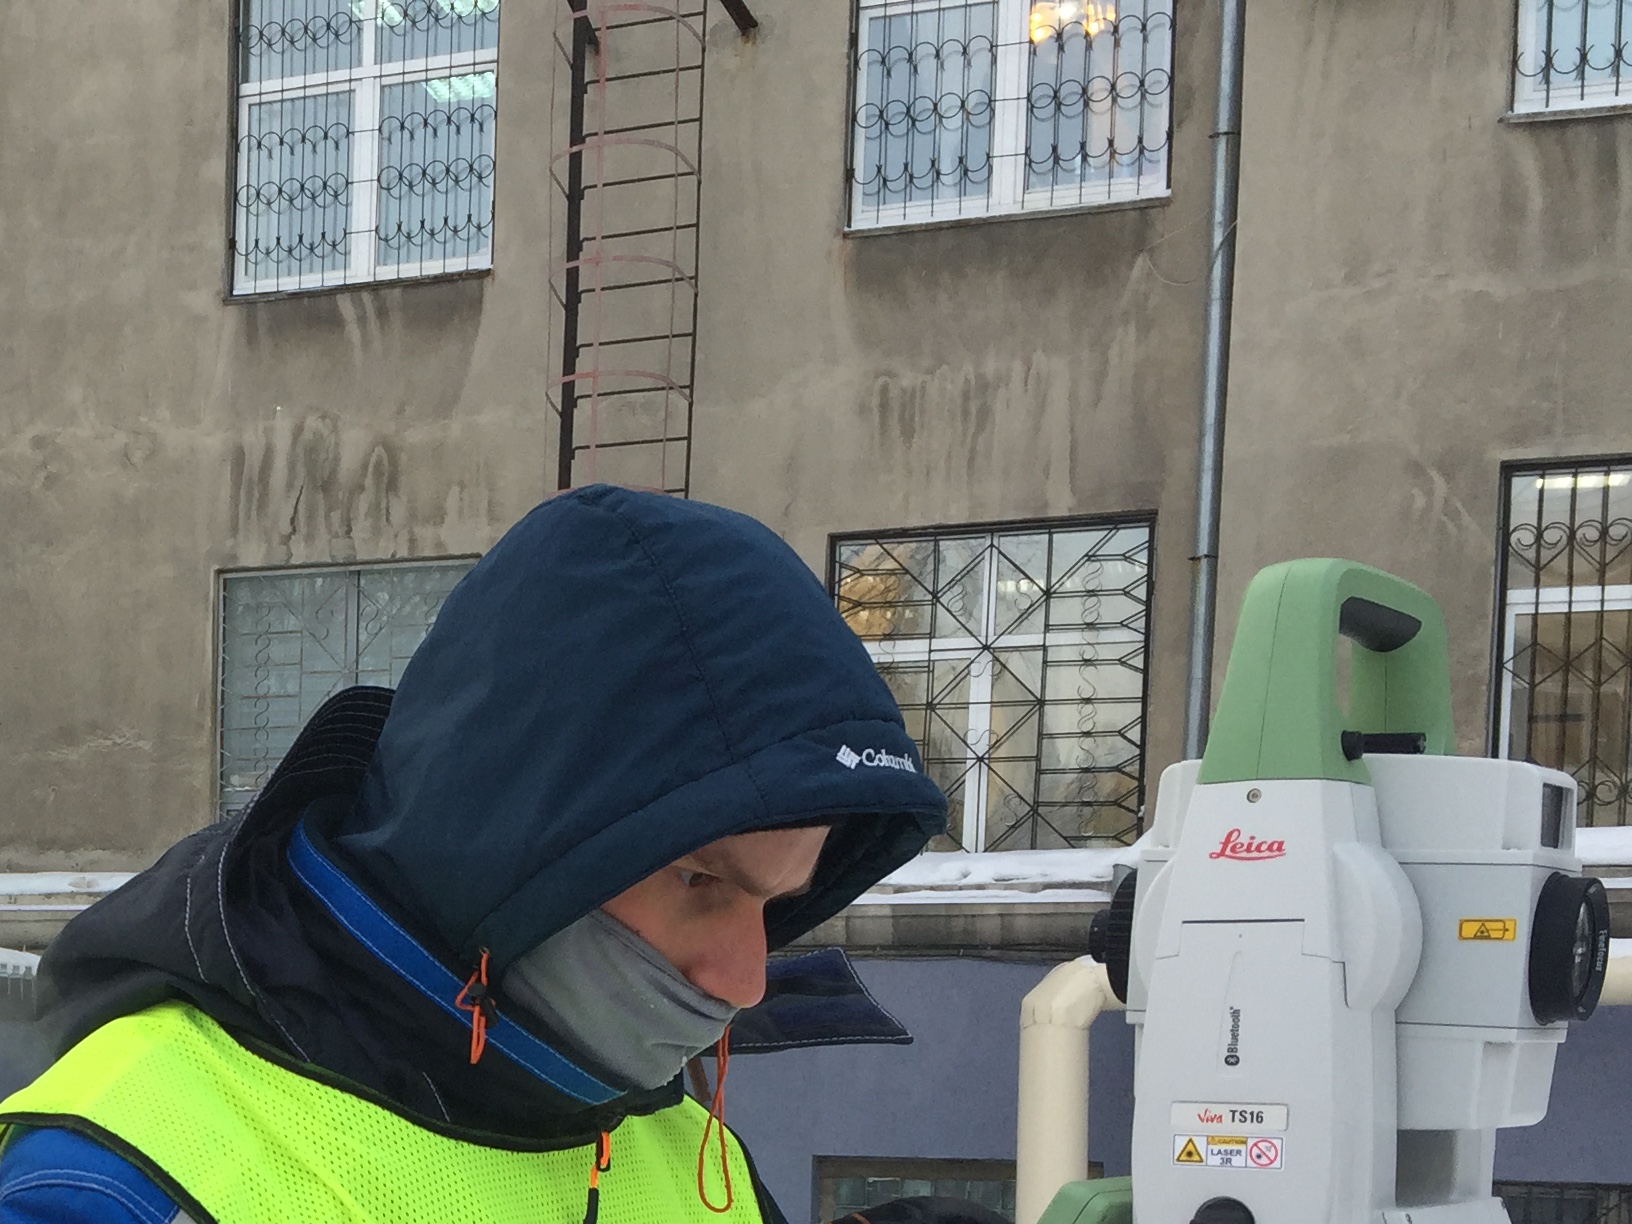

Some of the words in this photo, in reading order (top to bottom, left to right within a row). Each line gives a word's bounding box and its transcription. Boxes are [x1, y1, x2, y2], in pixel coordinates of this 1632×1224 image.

[1209, 828, 1286, 861] Leica
[1227, 1008, 1241, 1054] Bluetooth
[1197, 1108, 1224, 1124] Viva
[1229, 1109, 1264, 1124] TS16
[1210, 1148, 1243, 1157] LASER
[1219, 1157, 1233, 1166] 3R
